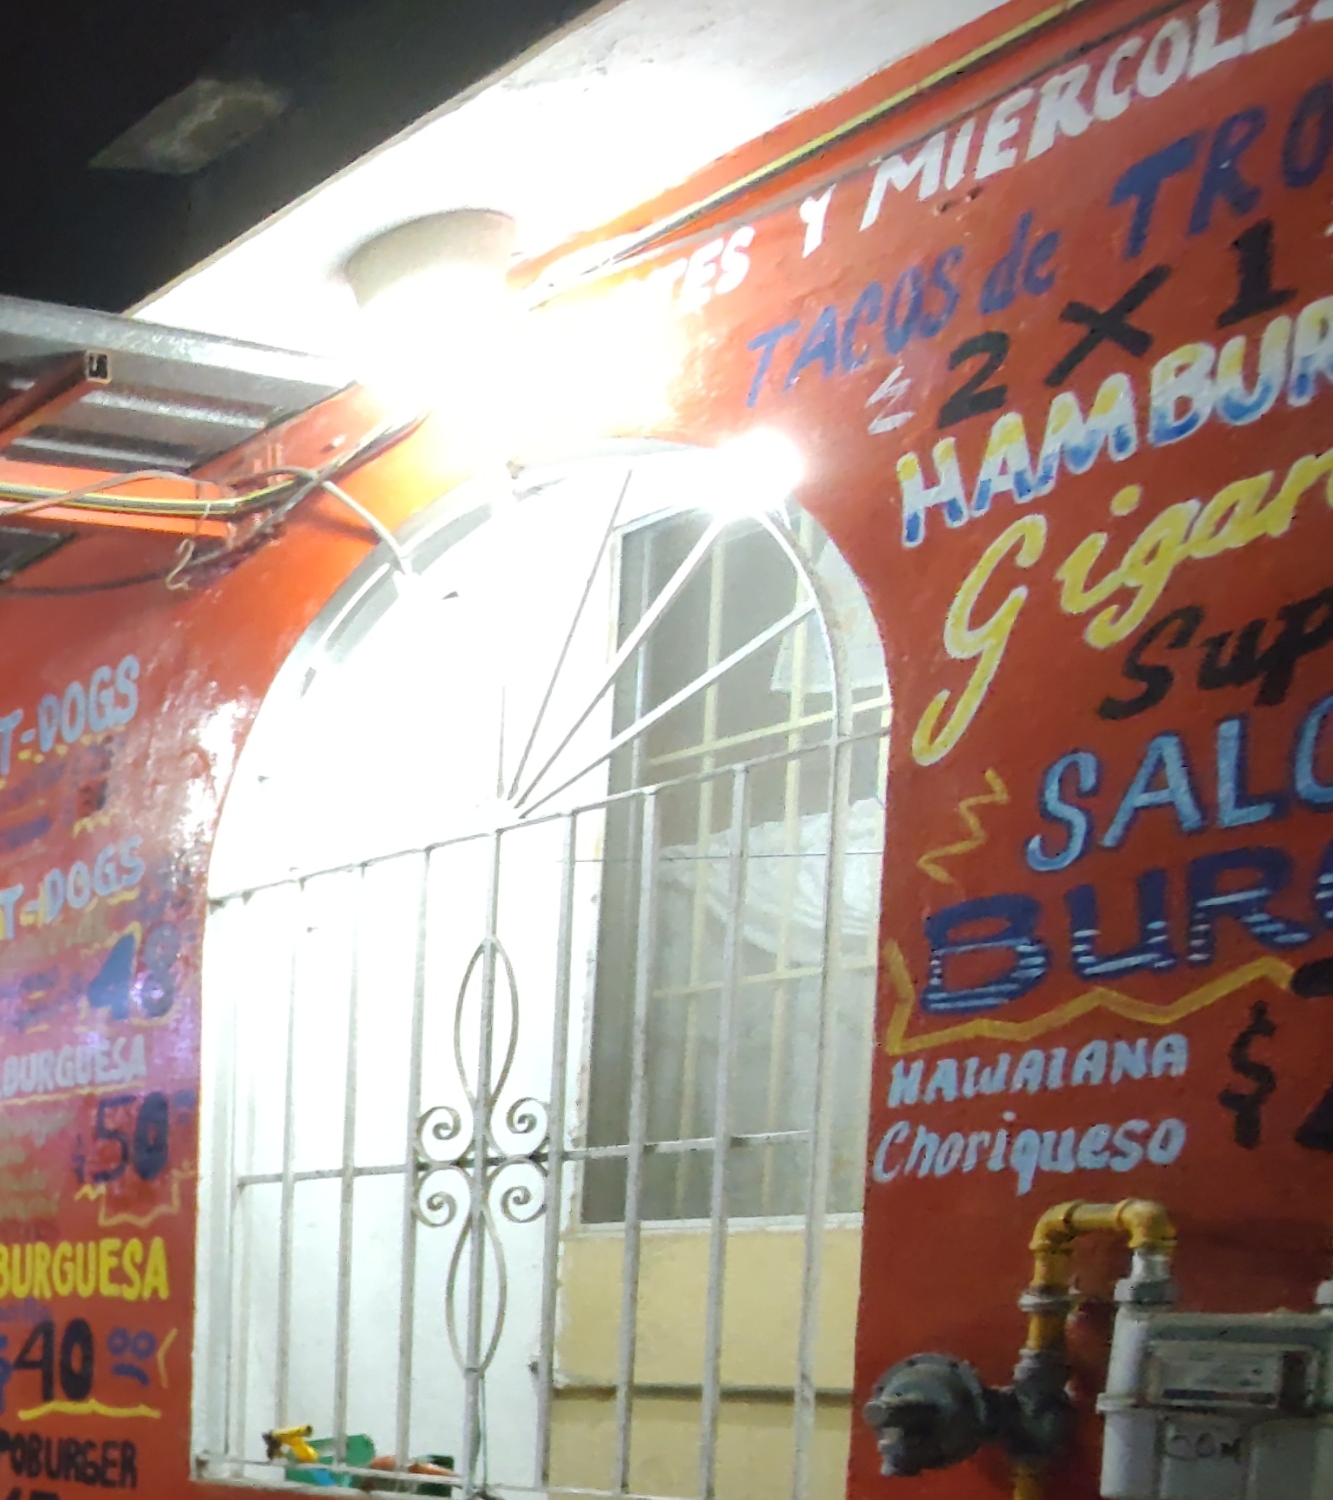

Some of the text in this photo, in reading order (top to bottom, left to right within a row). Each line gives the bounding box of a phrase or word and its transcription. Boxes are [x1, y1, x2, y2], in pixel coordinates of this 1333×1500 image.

[745, 245, 965, 408] TACOS
[981, 209, 1062, 315] de
[937, 330, 1012, 430] 2
[919, 838, 1333, 1016] BUR
[888, 1031, 1189, 1108] HAWAIANA
[872, 1110, 1188, 1197] Choriqueso
